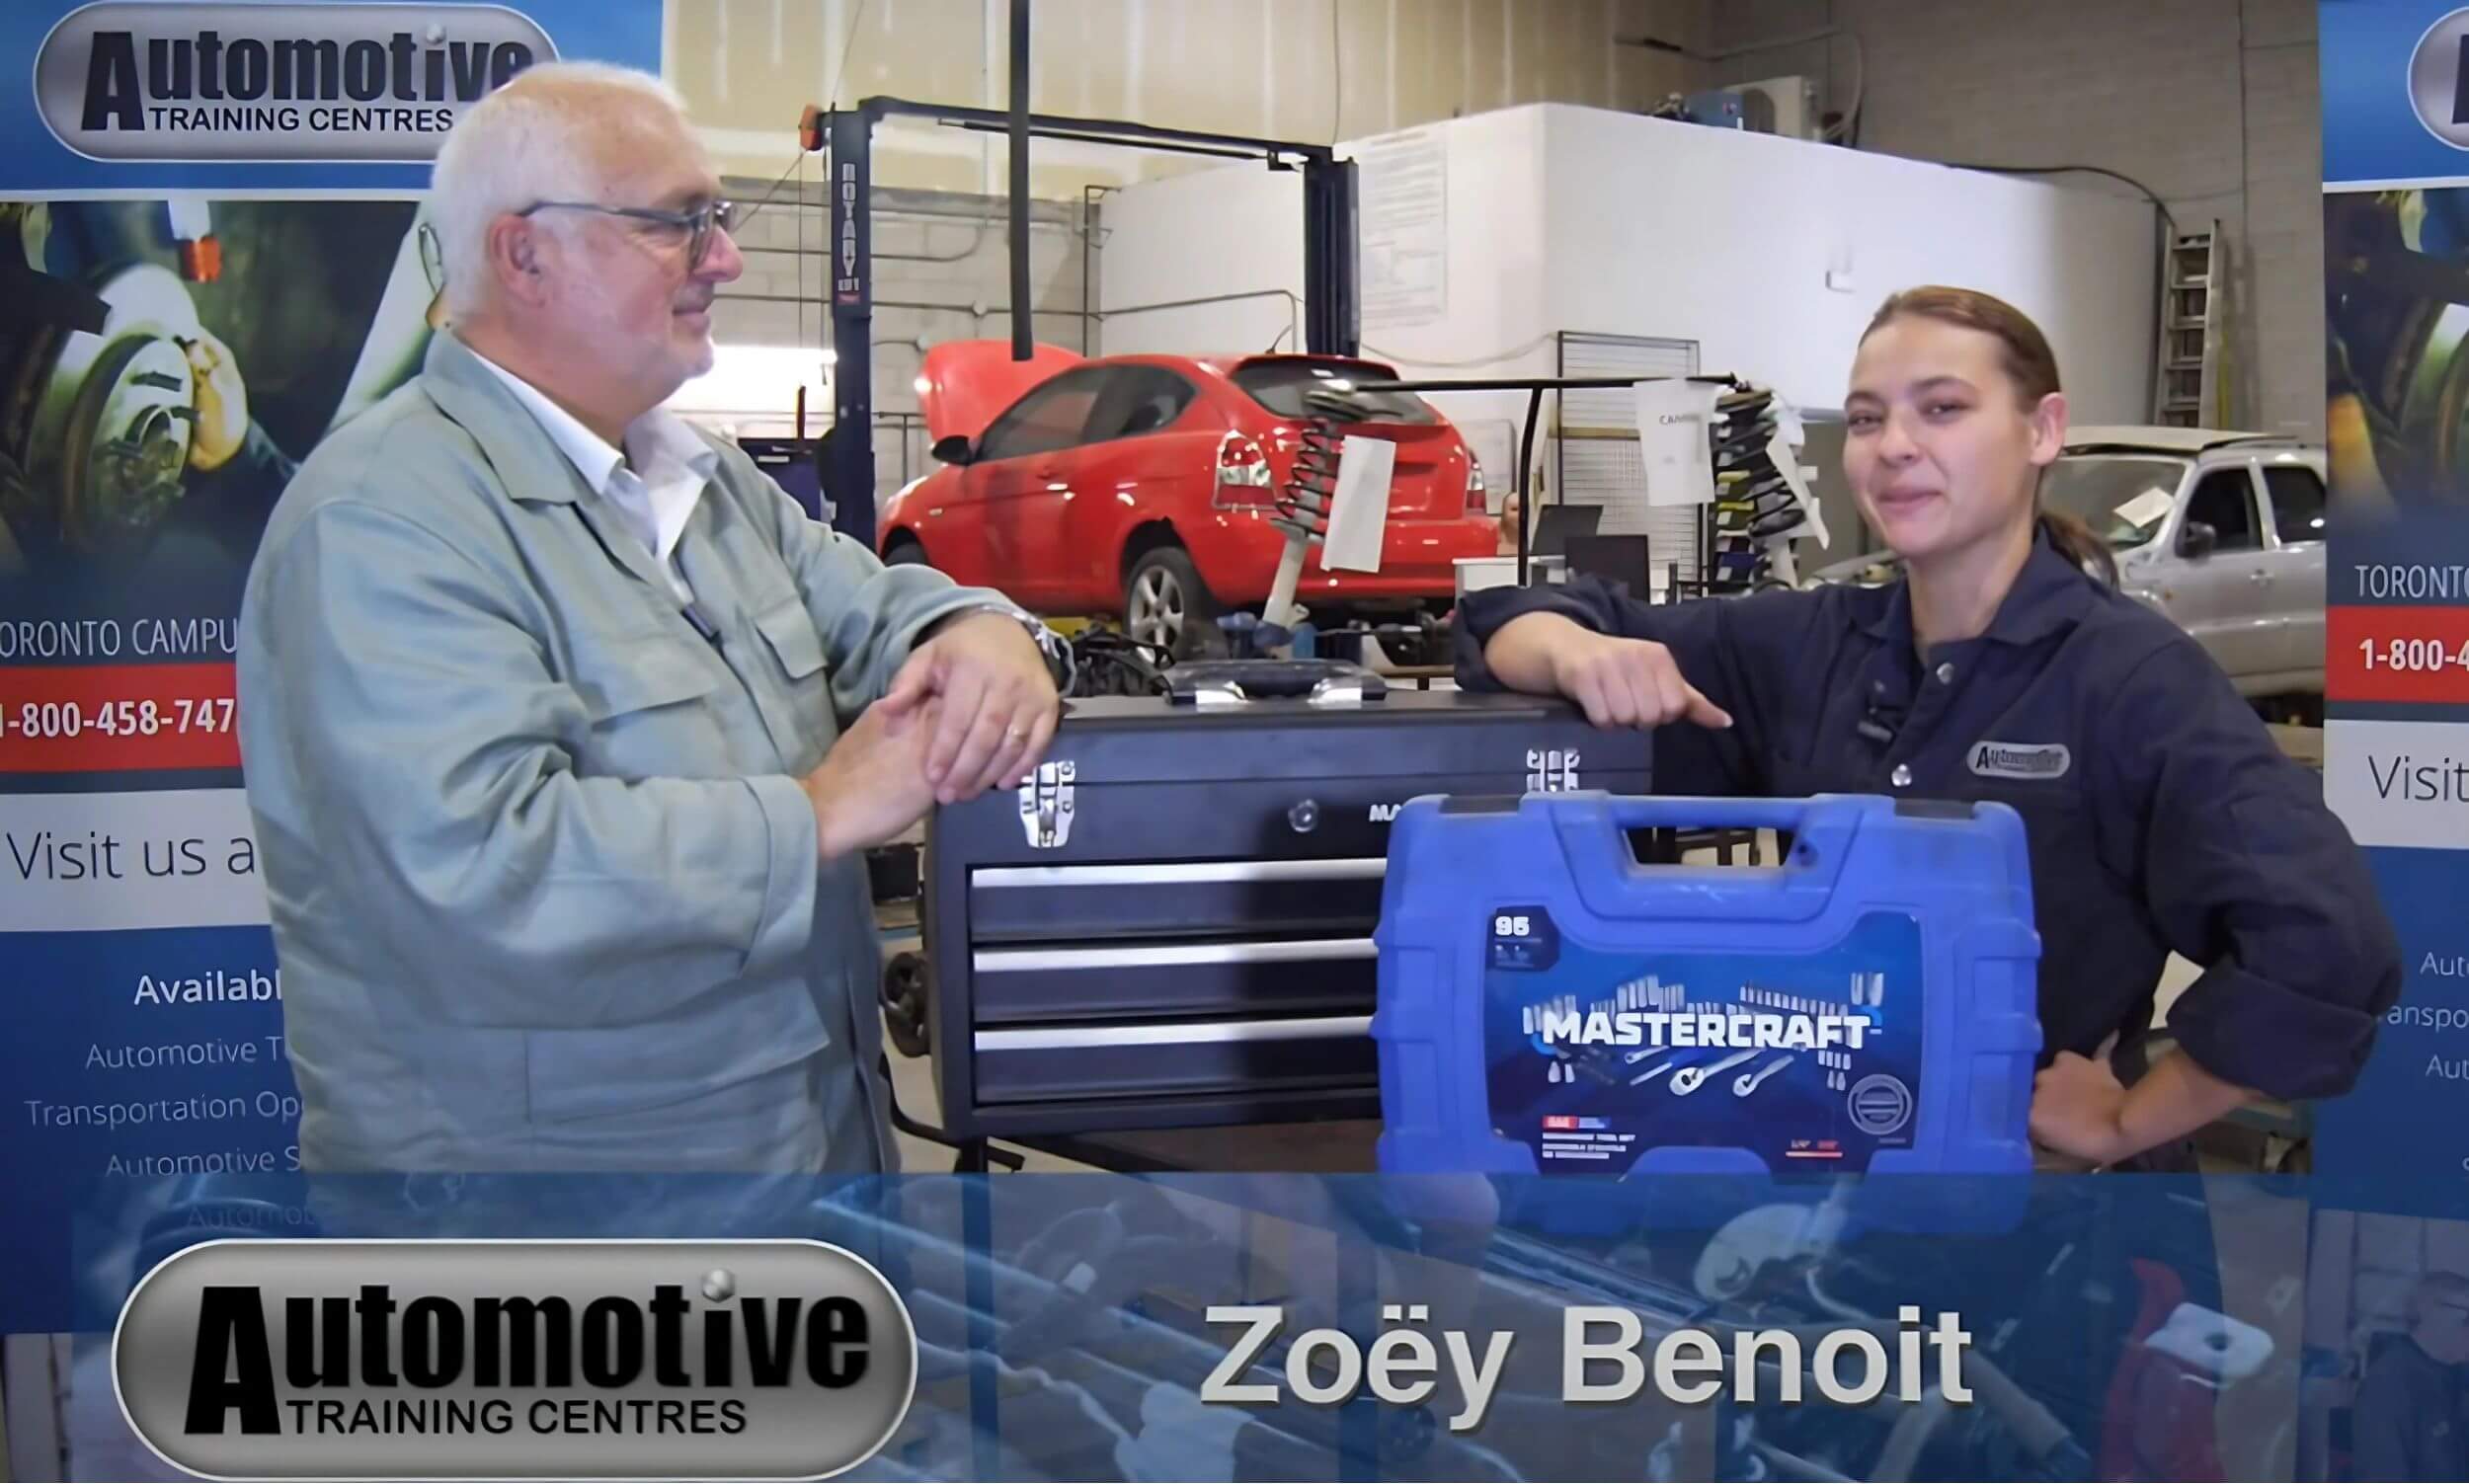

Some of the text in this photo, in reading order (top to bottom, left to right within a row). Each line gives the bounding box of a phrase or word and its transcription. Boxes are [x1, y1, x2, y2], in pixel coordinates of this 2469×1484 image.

[81, 25, 533, 130] Automotive
[148, 107, 453, 132] TRAINING CENTRES
[2354, 565, 2469, 598] TORONT
[2368, 754, 2469, 803] Visit
[6, 831, 122, 880] Visit
[144, 837, 206, 877] us
[2420, 951, 2469, 977] Aut
[1542, 1010, 1872, 1050] MASTERCRAFT
[2377, 1005, 2469, 1033] anspo
[86, 1038, 258, 1070] Automotive
[24, 1090, 304, 1132] Transportation Op
[105, 1146, 276, 1178] Automotive
